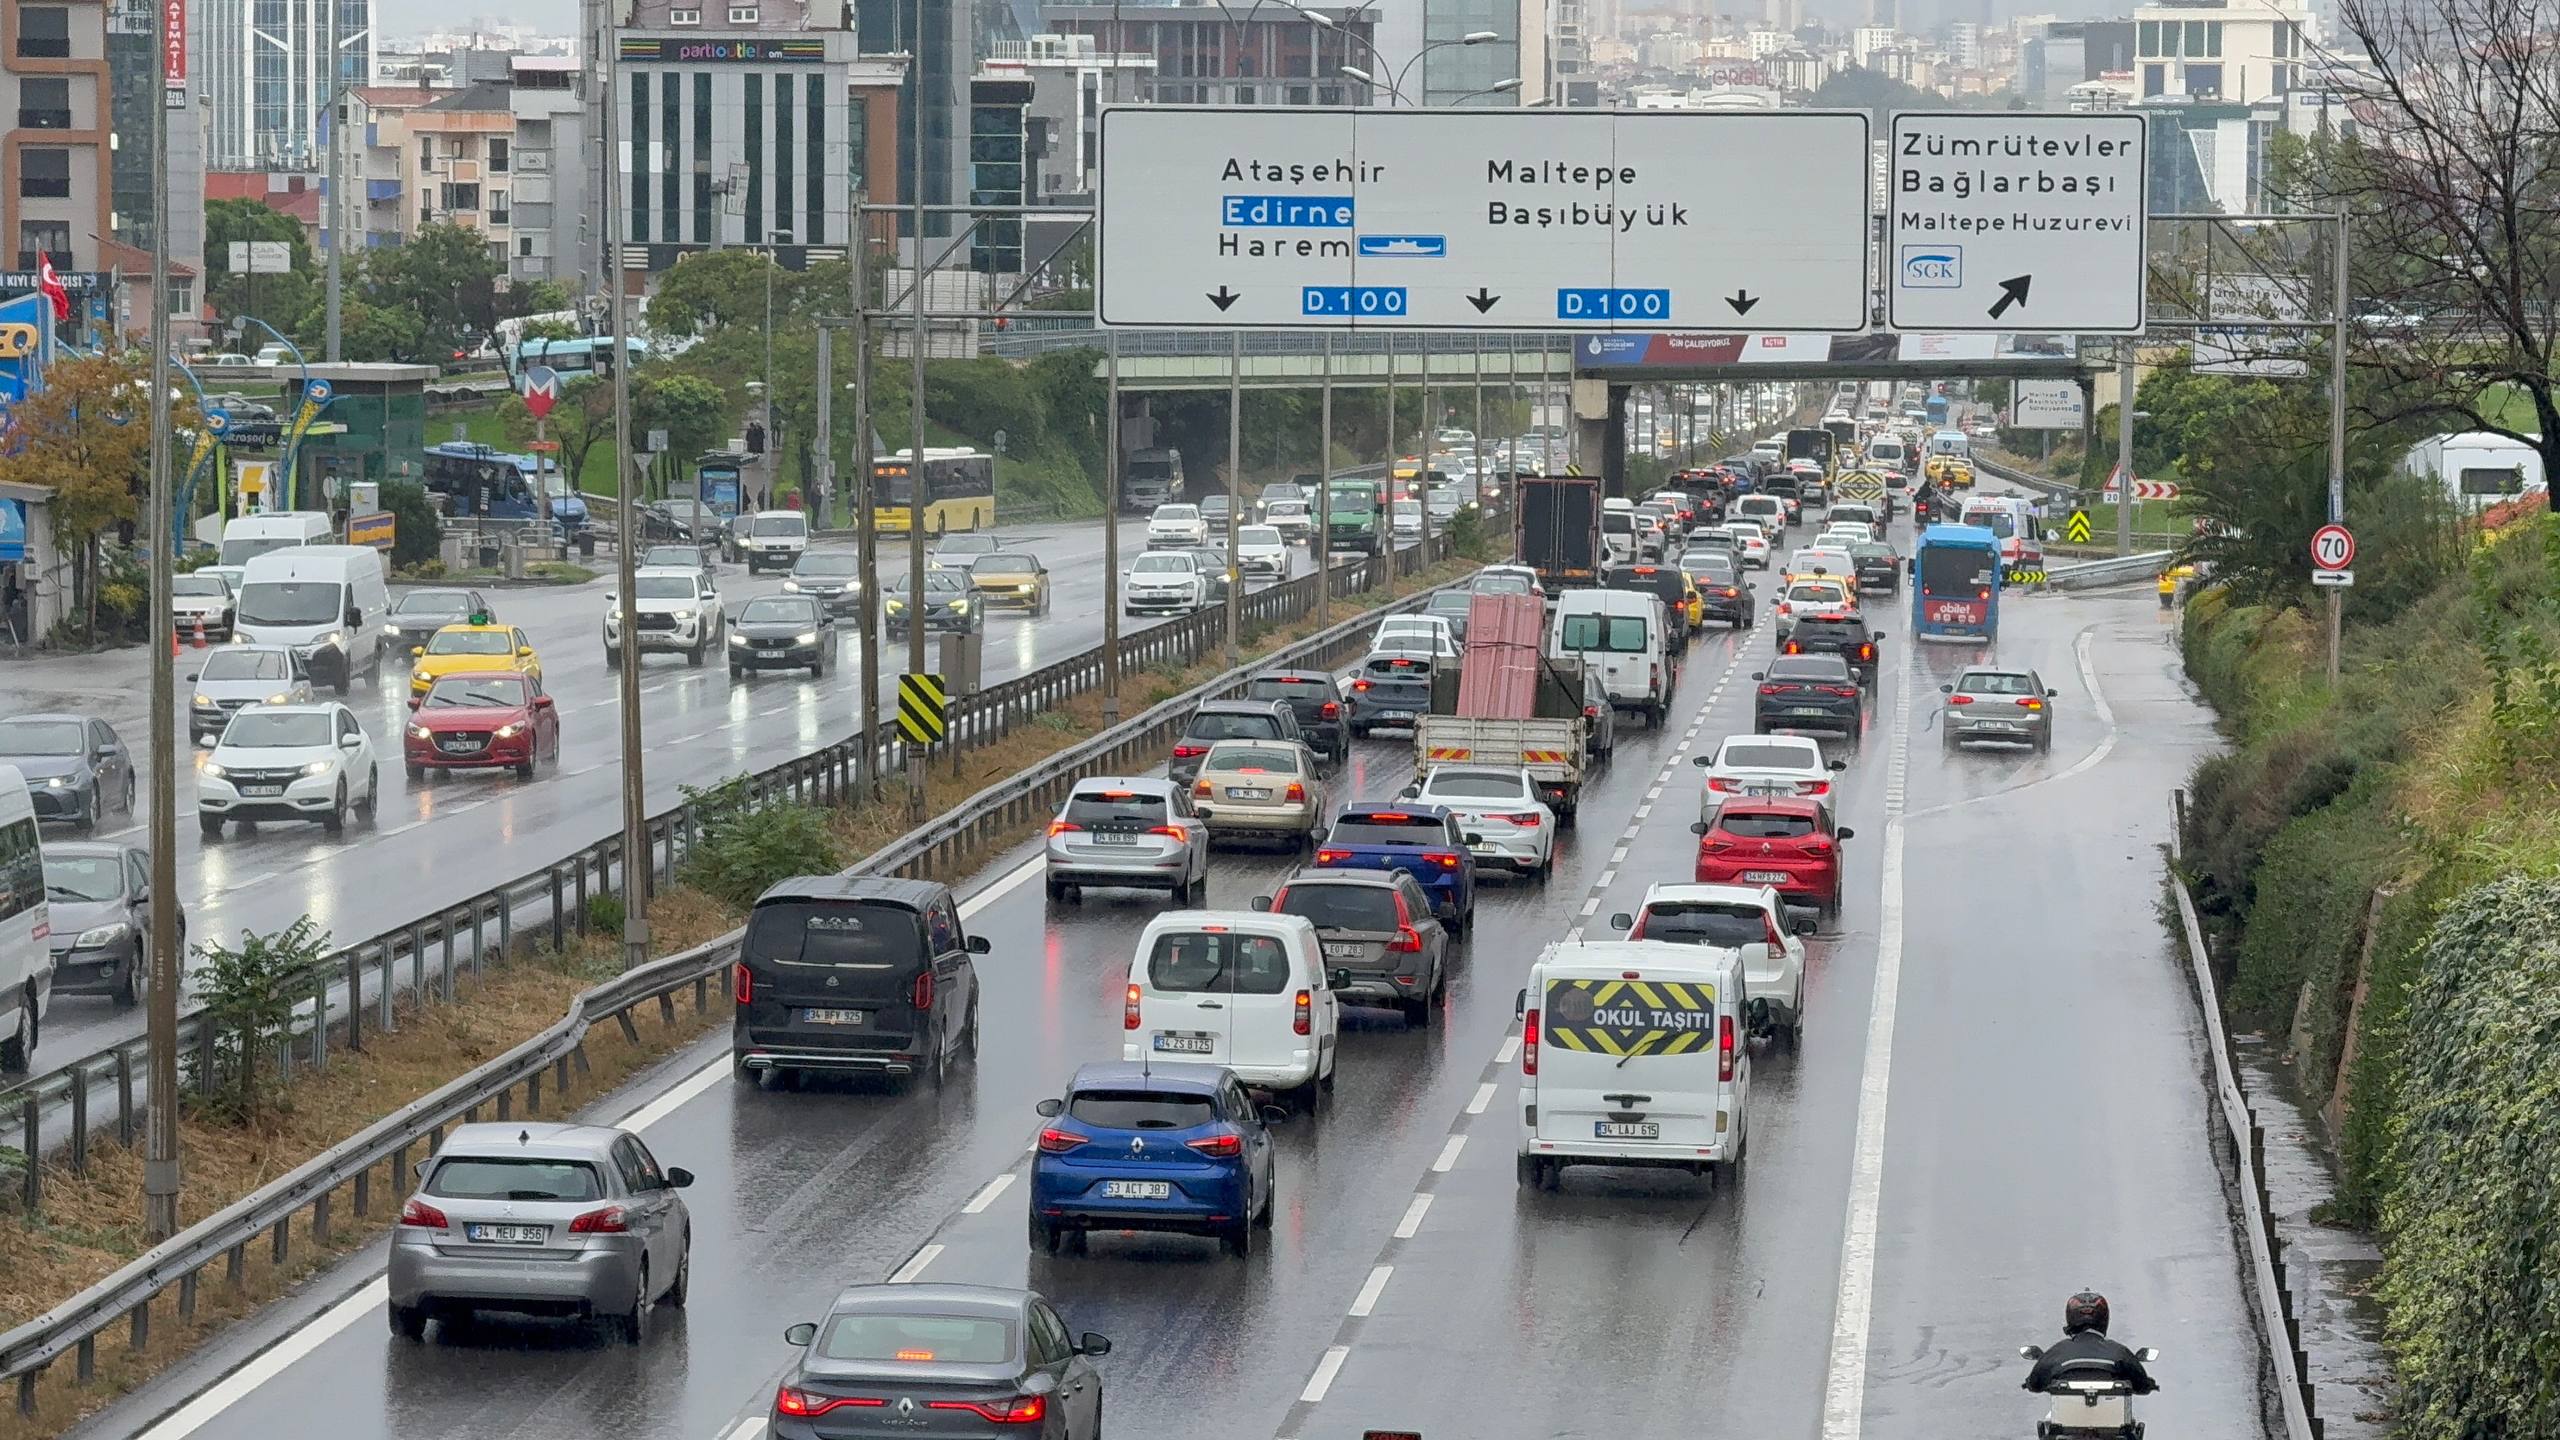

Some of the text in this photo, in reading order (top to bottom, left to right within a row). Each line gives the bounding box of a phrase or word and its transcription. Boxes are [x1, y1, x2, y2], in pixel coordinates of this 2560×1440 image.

[1903, 133, 2132, 157] Zümrütevler
[1222, 158, 1385, 186] Ataşehir
[1488, 160, 1637, 188] Maltepe
[1902, 169, 2116, 198] Bağlarbaşı
[1226, 197, 1353, 225] Edirne
[1489, 202, 1689, 232] Başıbüyük
[1901, 212, 2132, 235] Maltepe Huzurevi
[1219, 233, 1351, 258] Harem
[1912, 262, 1953, 280] SGK
[1307, 291, 1402, 312] D.100
[1566, 293, 1661, 315] D.100
[2321, 538, 2345, 558] 70
[1940, 602, 1970, 614] obilet
[811, 1009, 821, 1018] 34
[844, 1011, 861, 1021] 925
[1593, 1008, 1710, 1033] OKUL TAŞITI
[1160, 1038, 1210, 1050] 34 ZS 8125
[1602, 1124, 1657, 1135] 34 LAJ 615
[1108, 1182, 1167, 1195] 53 ACT 383
[476, 1224, 542, 1241] 34 MEU 956
